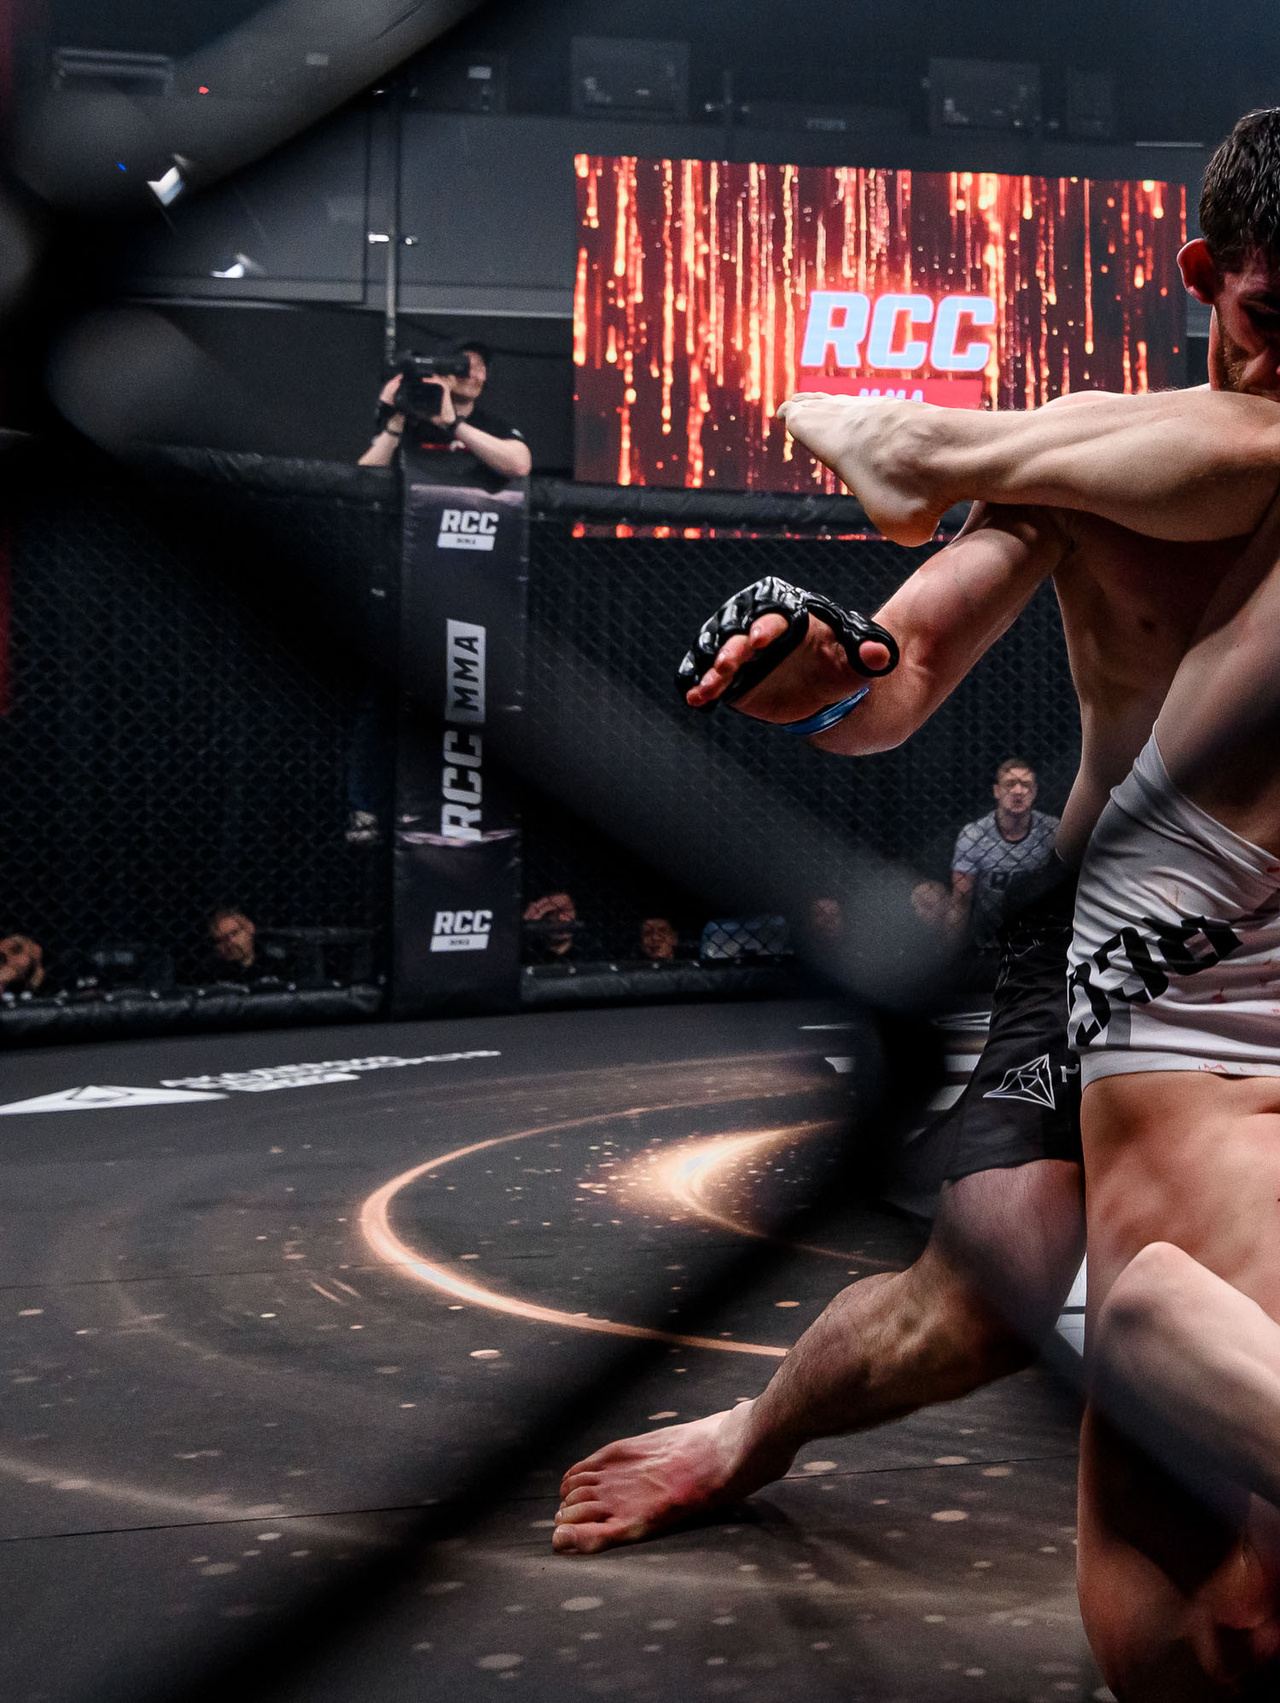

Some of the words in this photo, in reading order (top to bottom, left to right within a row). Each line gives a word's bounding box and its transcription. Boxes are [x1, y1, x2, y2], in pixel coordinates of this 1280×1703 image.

[801, 290, 996, 371] RCC
[440, 508, 499, 534] RCC
[453, 635, 480, 713] MMA
[441, 730, 483, 842] RCC
[433, 909, 494, 934] RCC
